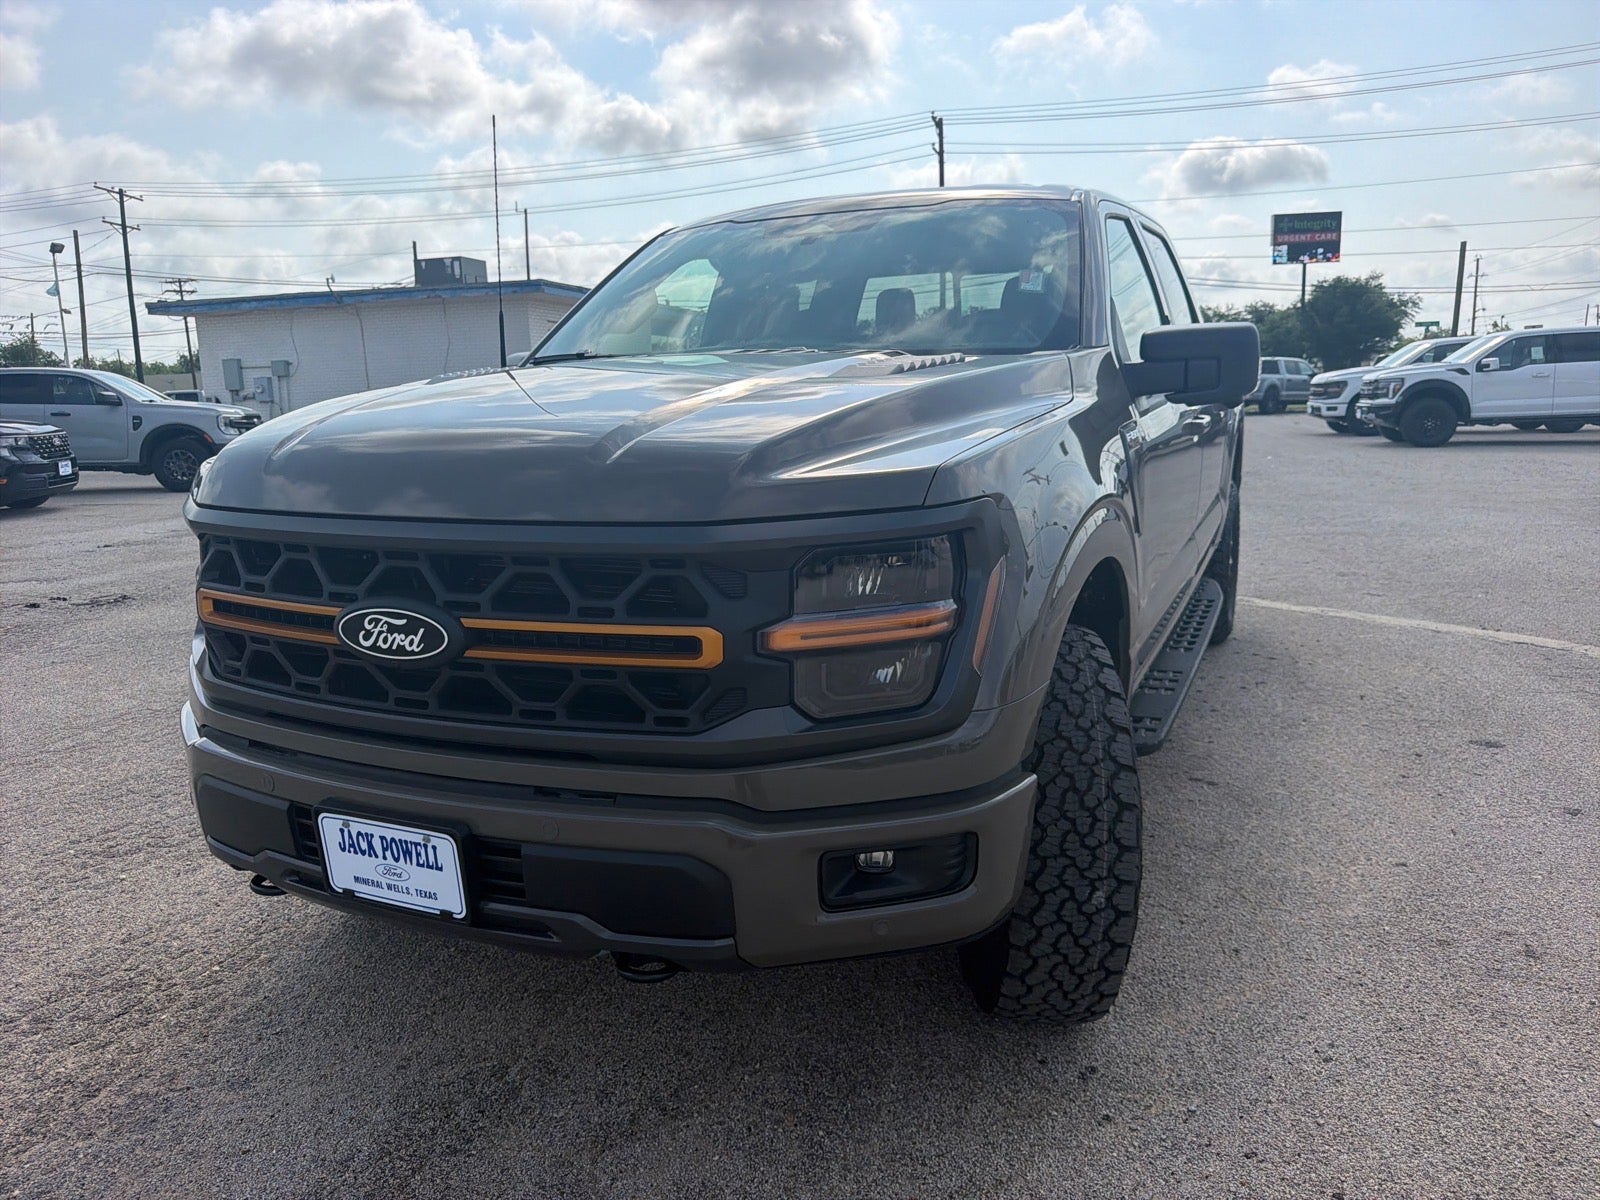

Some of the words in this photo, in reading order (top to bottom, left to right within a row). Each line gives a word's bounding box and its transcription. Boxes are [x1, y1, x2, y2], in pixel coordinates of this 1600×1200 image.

[1294, 218, 1337, 230] Integrity
[1277, 233, 1311, 242] URGENT
[1314, 232, 1337, 241] CARE
[359, 614, 425, 652] Ford
[338, 827, 379, 859] JACK
[378, 835, 443, 872] POWELL
[381, 865, 403, 879] Ford
[353, 875, 384, 890] MINERAL
[385, 882, 413, 897] WELLS,
[415, 888, 438, 901] TEXAS
